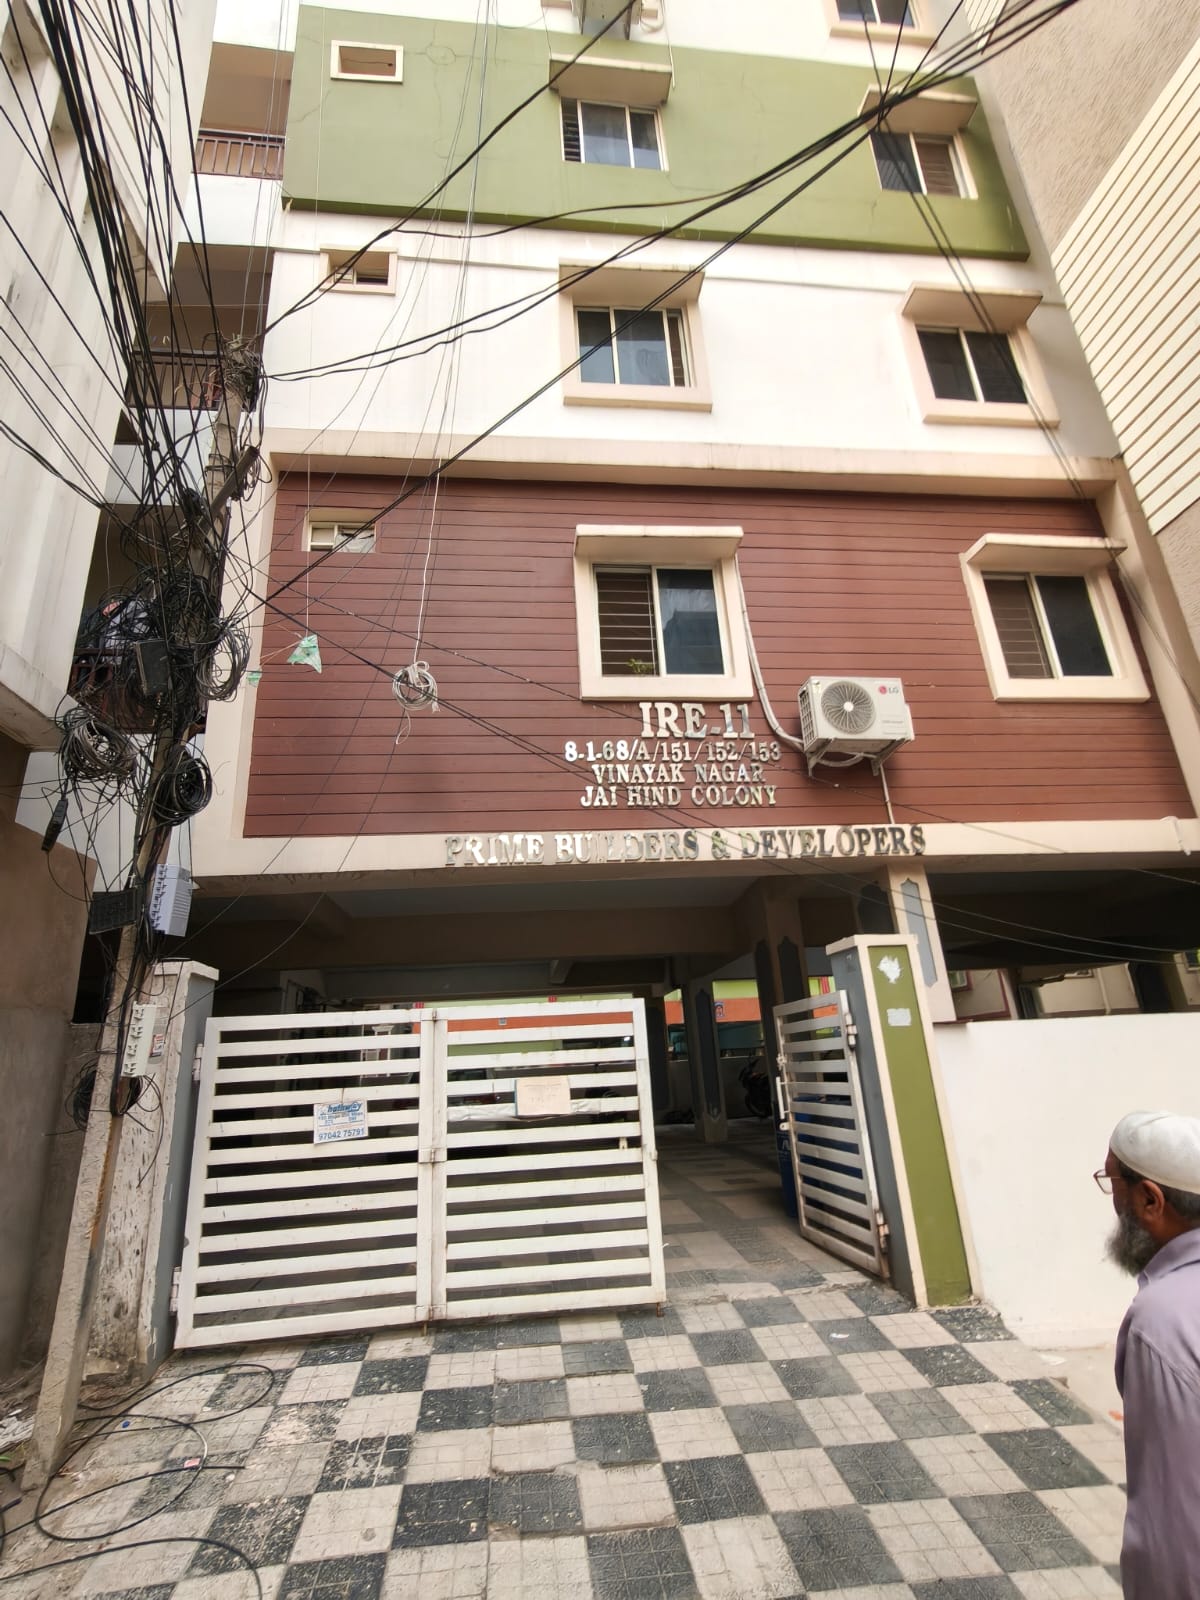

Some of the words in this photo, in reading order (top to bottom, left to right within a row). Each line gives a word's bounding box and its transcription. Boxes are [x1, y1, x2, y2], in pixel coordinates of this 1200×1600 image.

[592, 764, 685, 784] VINAYAK
[695, 764, 765, 783] NAGAR
[580, 786, 618, 806] JAI
[627, 786, 681, 806] HIND
[691, 785, 777, 806] COLONY
[445, 833, 544, 866] PRIME
[554, 829, 699, 863] BUILDERS
[711, 830, 731, 859] &
[739, 825, 926, 858] DEVELOPERS
